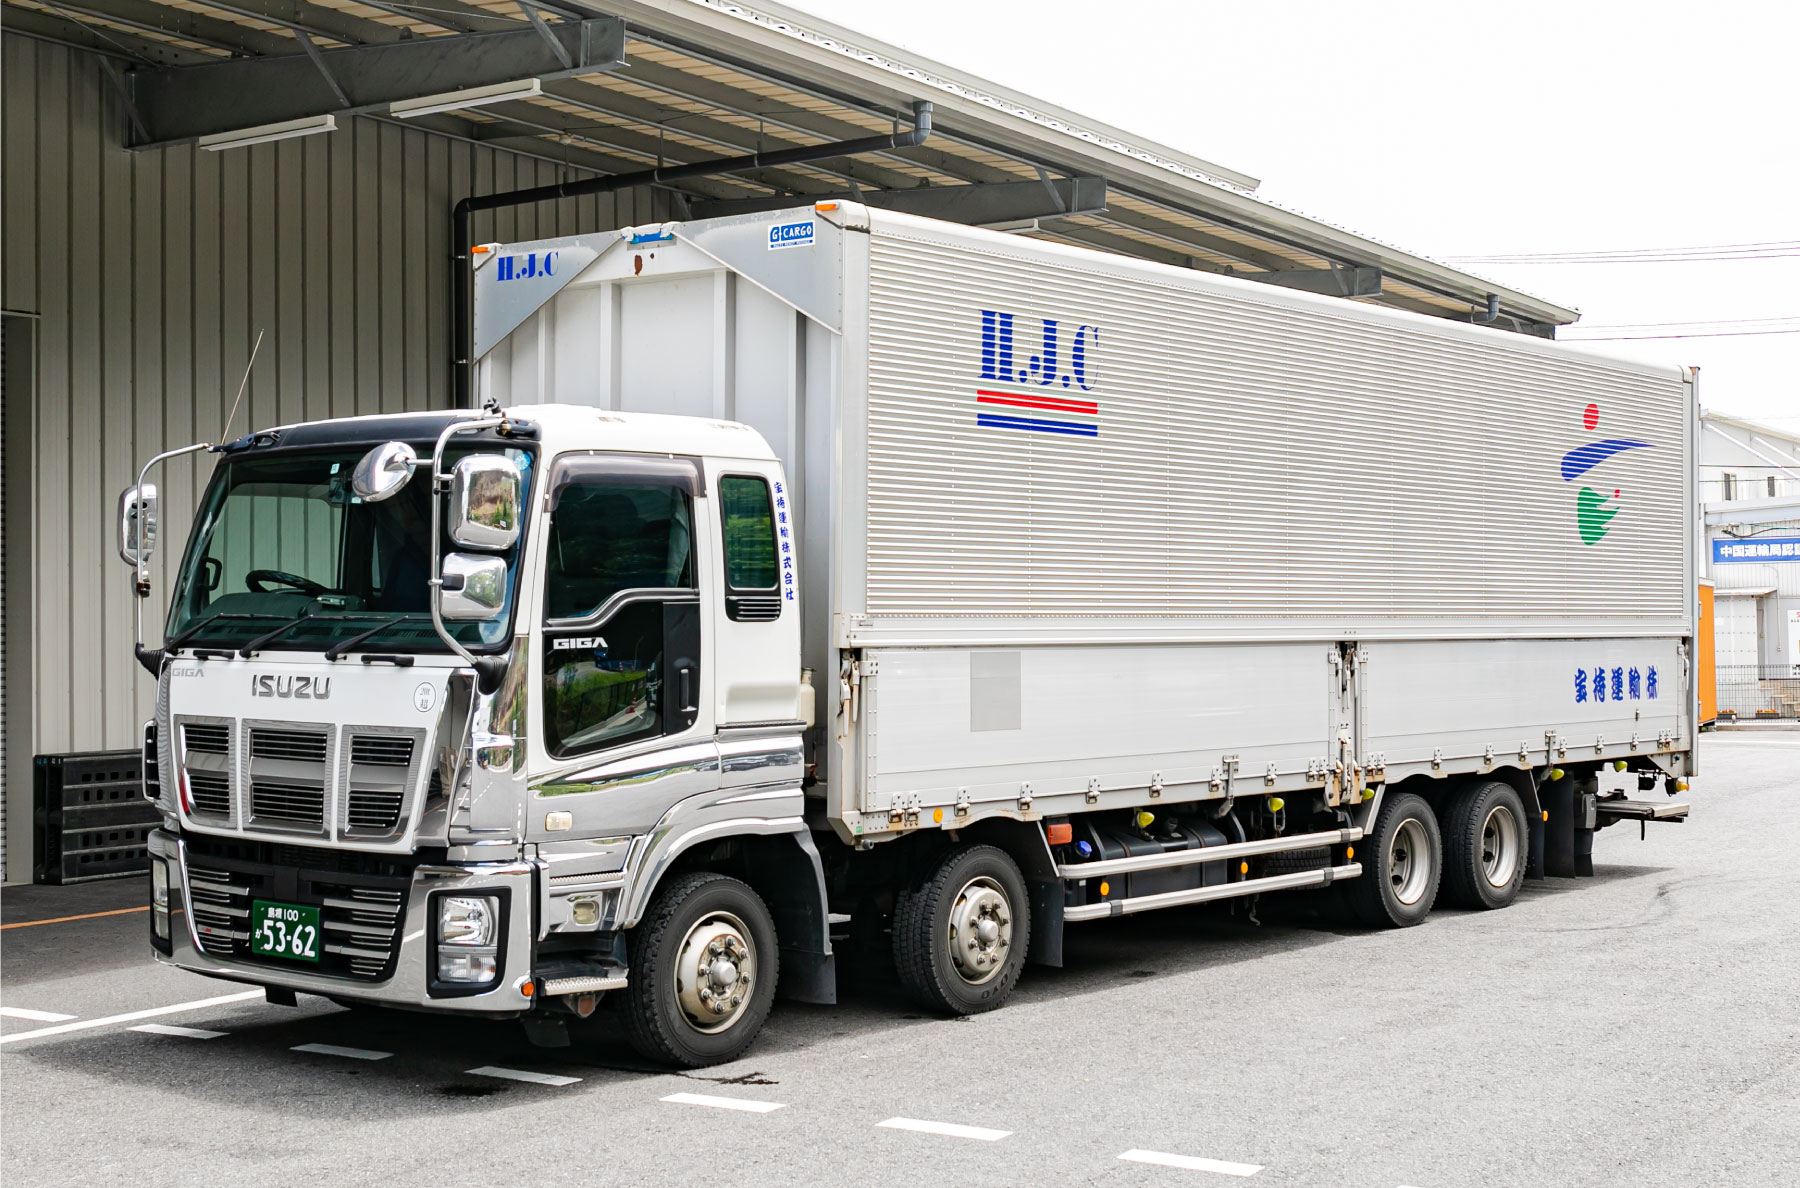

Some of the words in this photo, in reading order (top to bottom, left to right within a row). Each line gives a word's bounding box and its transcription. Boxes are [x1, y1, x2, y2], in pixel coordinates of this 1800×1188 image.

[496, 250, 559, 281] H.J.C
[978, 309, 1099, 390] H.J.C
[552, 636, 608, 650] GIGA
[171, 667, 204, 678] GIGA
[252, 674, 332, 700] ISUZU
[263, 919, 316, 957] 53-62
